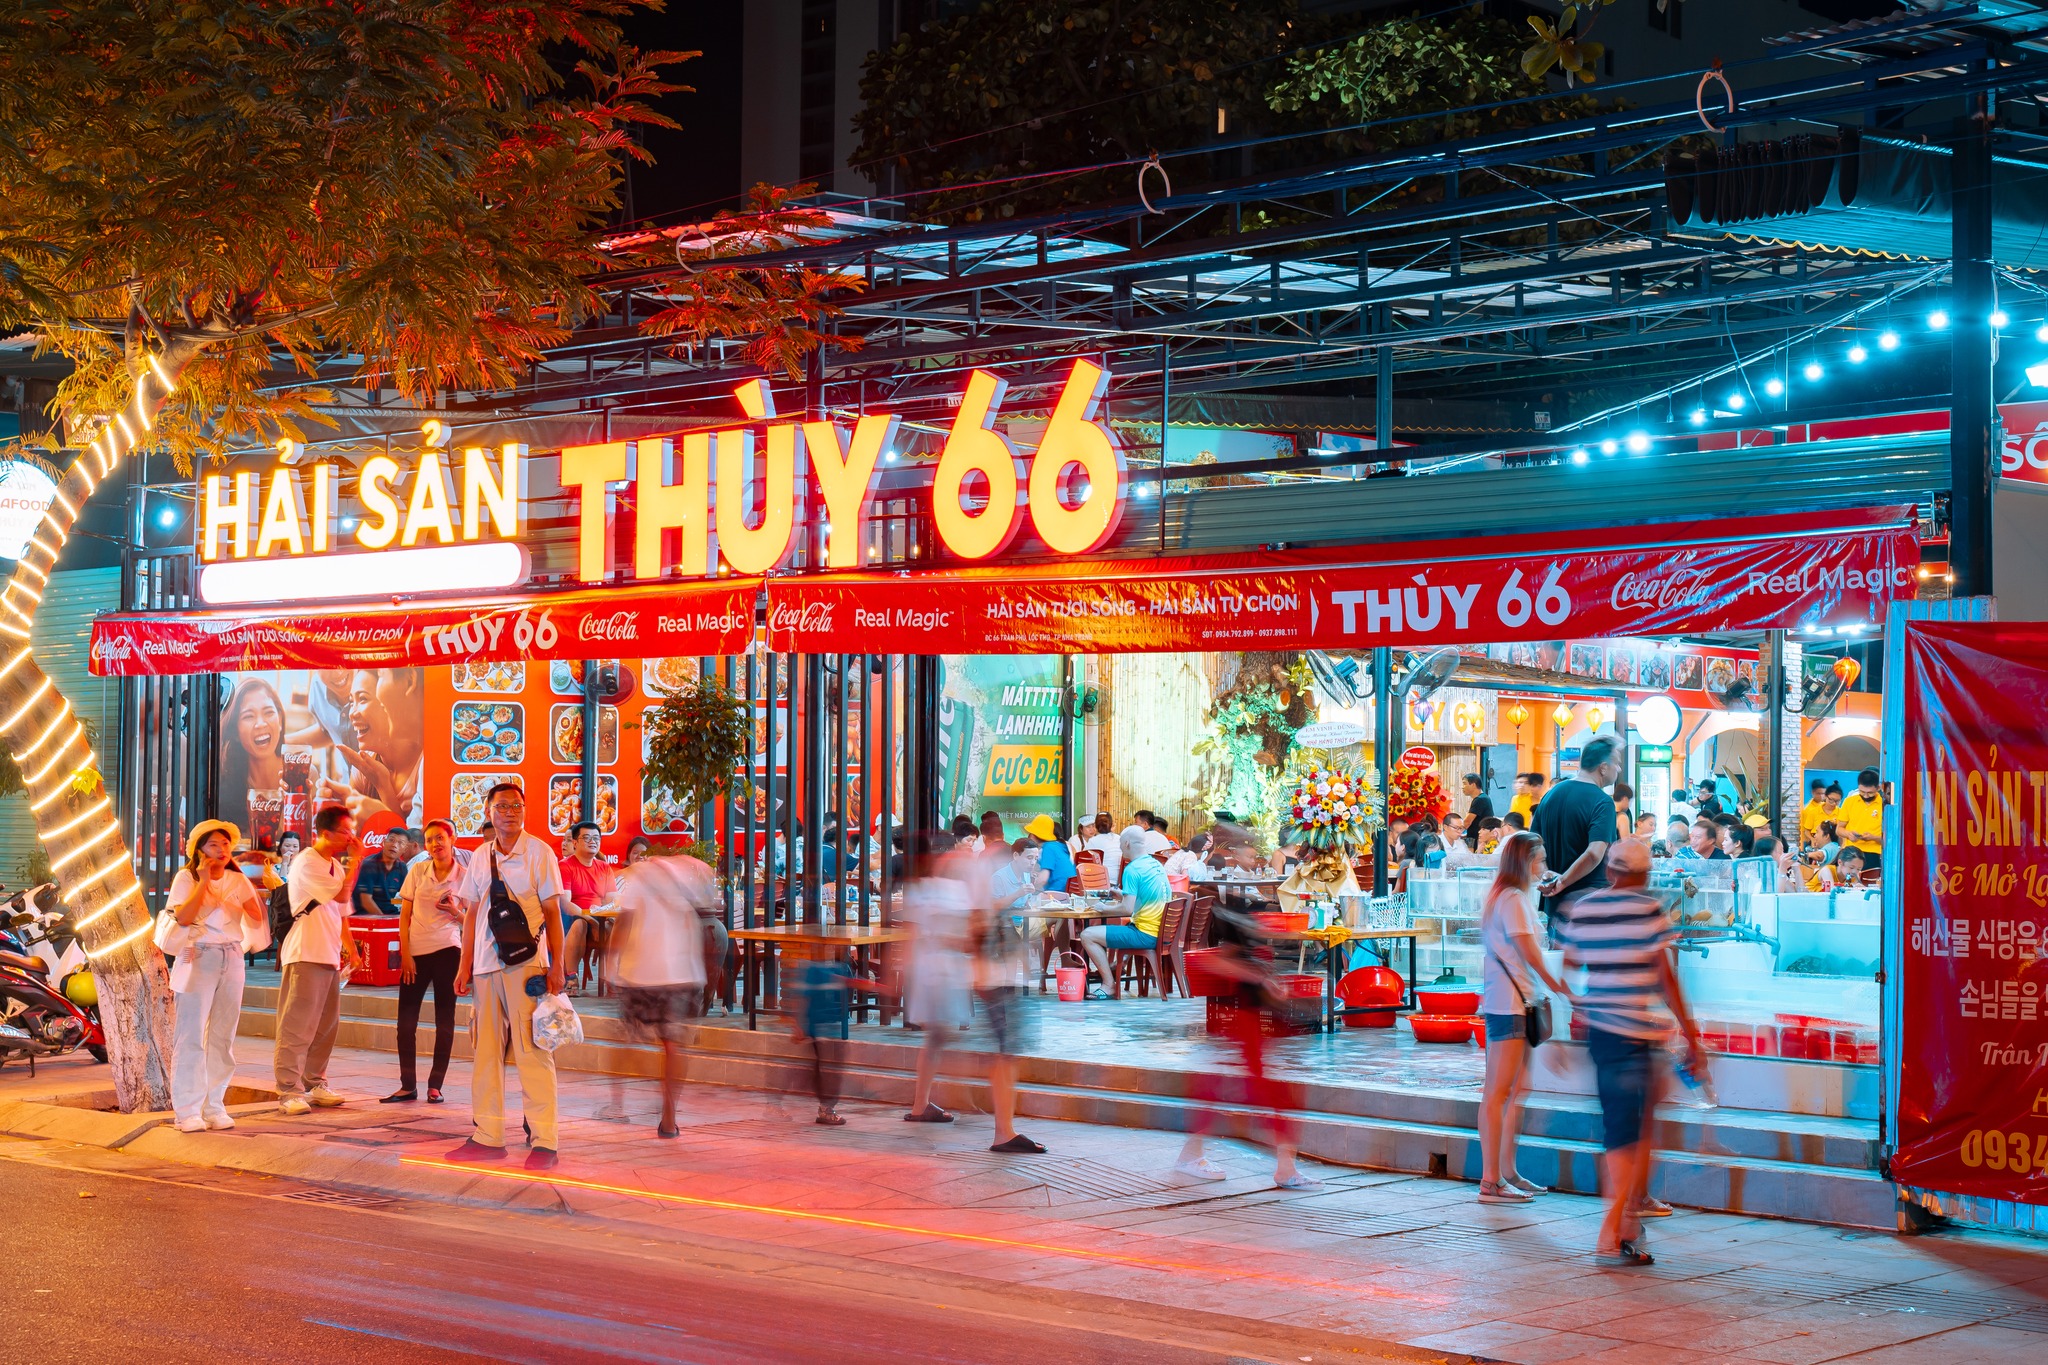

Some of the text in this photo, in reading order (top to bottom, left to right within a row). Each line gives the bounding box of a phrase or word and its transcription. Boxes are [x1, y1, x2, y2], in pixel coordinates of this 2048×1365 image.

[204, 357, 1120, 582] HẢI SẢN THÙY 66
[1611, 566, 1718, 612] Coca-Cola
[1749, 569, 1808, 596] Real
[769, 601, 836, 633] Coca-Cola
[855, 608, 890, 627] Real
[986, 596, 1013, 618] HẢI
[1016, 595, 1047, 618] SẢN
[1051, 600, 1088, 617] TƯƠI
[1090, 593, 1136, 617] SỐNG
[1149, 591, 1178, 615] HẢI
[1182, 591, 1215, 615] SẢN
[1219, 593, 1244, 617] TỰ
[1248, 593, 1298, 616] CHỌN
[1332, 568, 1569, 634] THÙY 66
[312, 626, 333, 642] HẢI
[332, 625, 356, 642] SẢN
[357, 627, 373, 644] TỰ
[372, 627, 403, 643] CHỌN
[421, 607, 558, 656] THÙY 66
[578, 610, 640, 641] Coca-Cola
[657, 610, 745, 634] Real Magic
[1215, 630, 1254, 638] 0934.792.899
[1258, 628, 1298, 637] 0937.898.111
[143, 640, 168, 655] Real
[991, 753, 1033, 792] CỰC
[1916, 743, 2048, 846] HẢI SẢN T
[1932, 862, 1966, 896] Sẽ
[1973, 863, 2018, 896] Mở
[1911, 917, 1972, 958] 해산물
[1976, 919, 2038, 960] 식당은
[1959, 979, 2039, 1020] 손님들을
[1981, 1041, 2033, 1065] Trân
[1961, 1130, 2048, 1175] 0934
